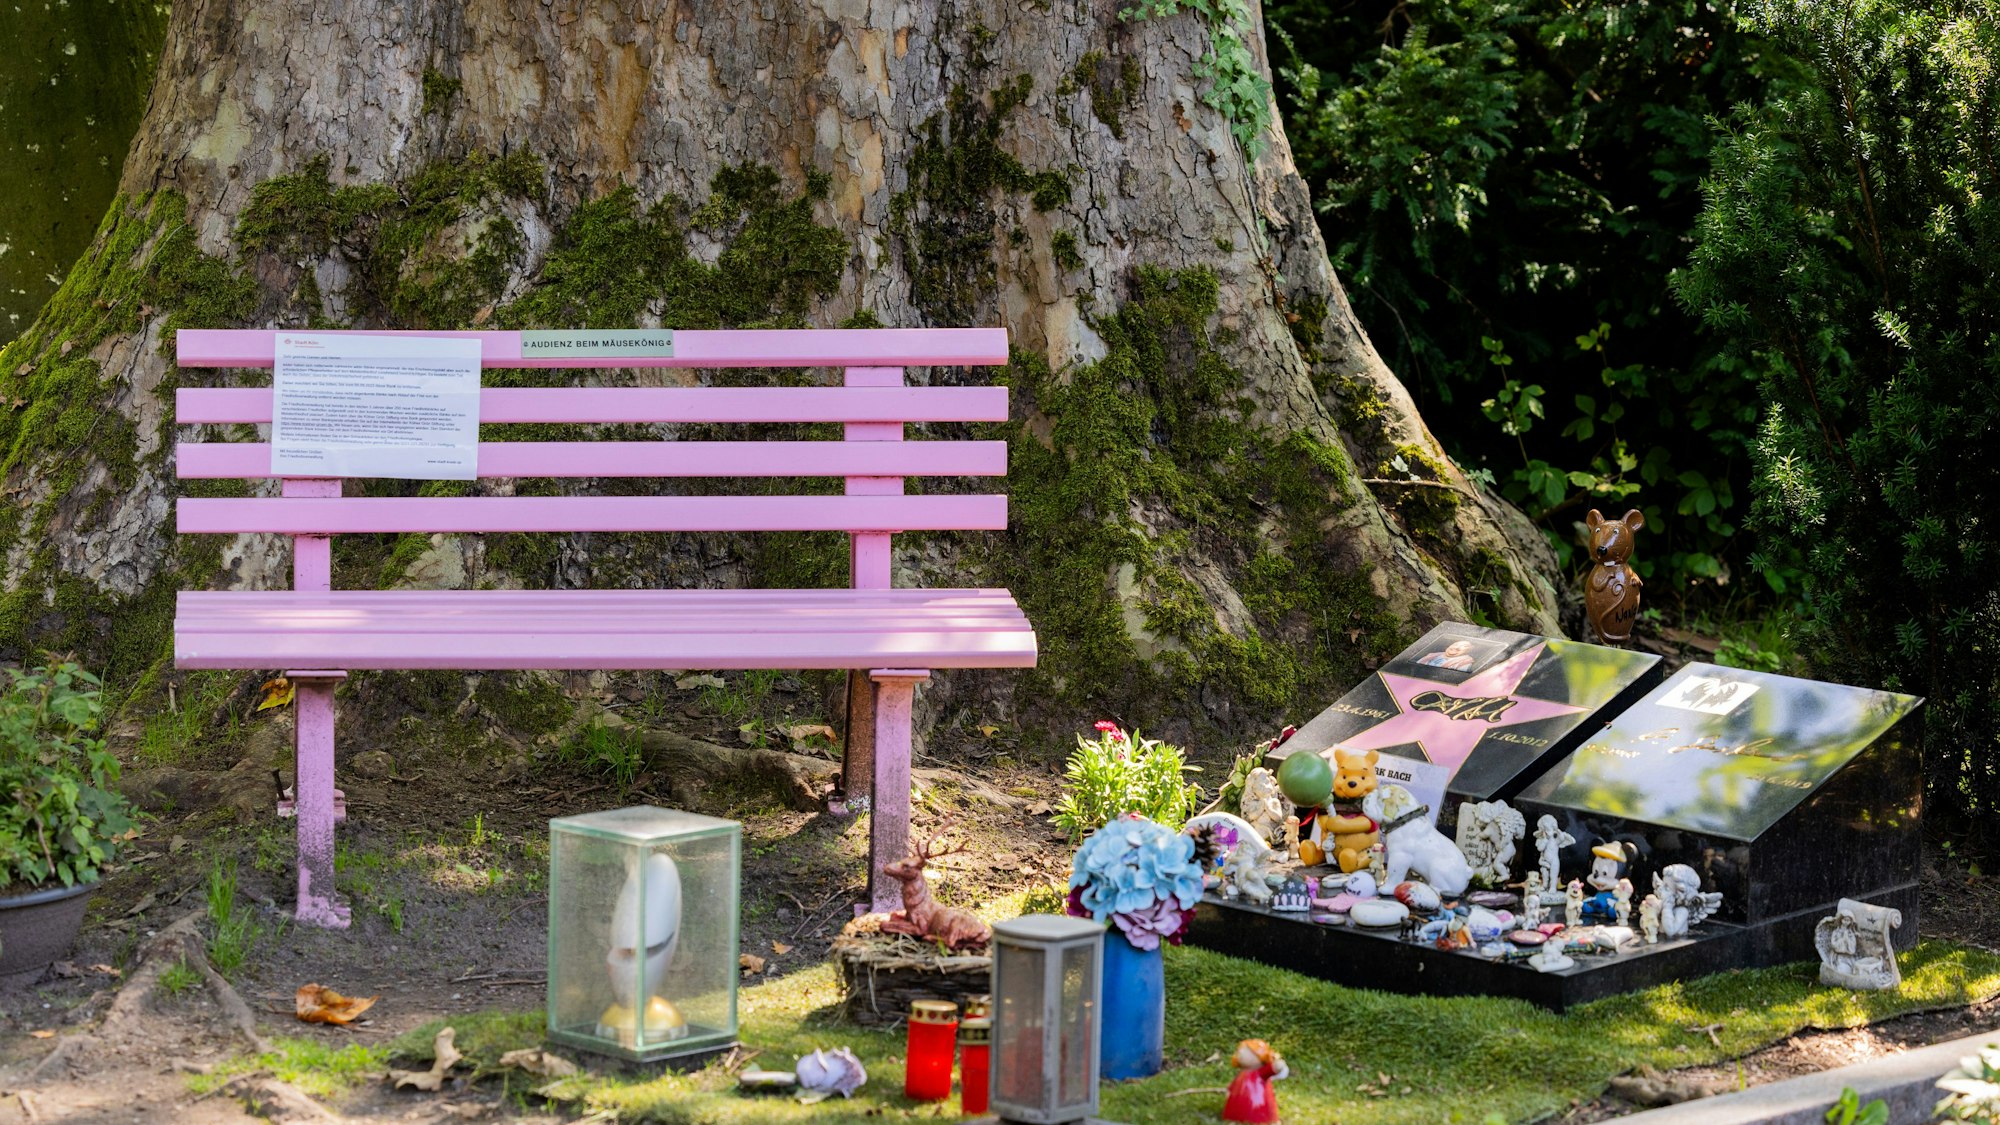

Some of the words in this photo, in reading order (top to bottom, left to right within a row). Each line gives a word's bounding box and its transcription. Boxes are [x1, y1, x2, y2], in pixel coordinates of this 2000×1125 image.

[531, 340, 573, 348] AUDIENZ
[576, 340, 599, 348] BEIM
[602, 338, 665, 347] MÄUSEKÖNIG
[1487, 732, 1549, 748] 1.10.2012
[1387, 769, 1412, 782] BACH
